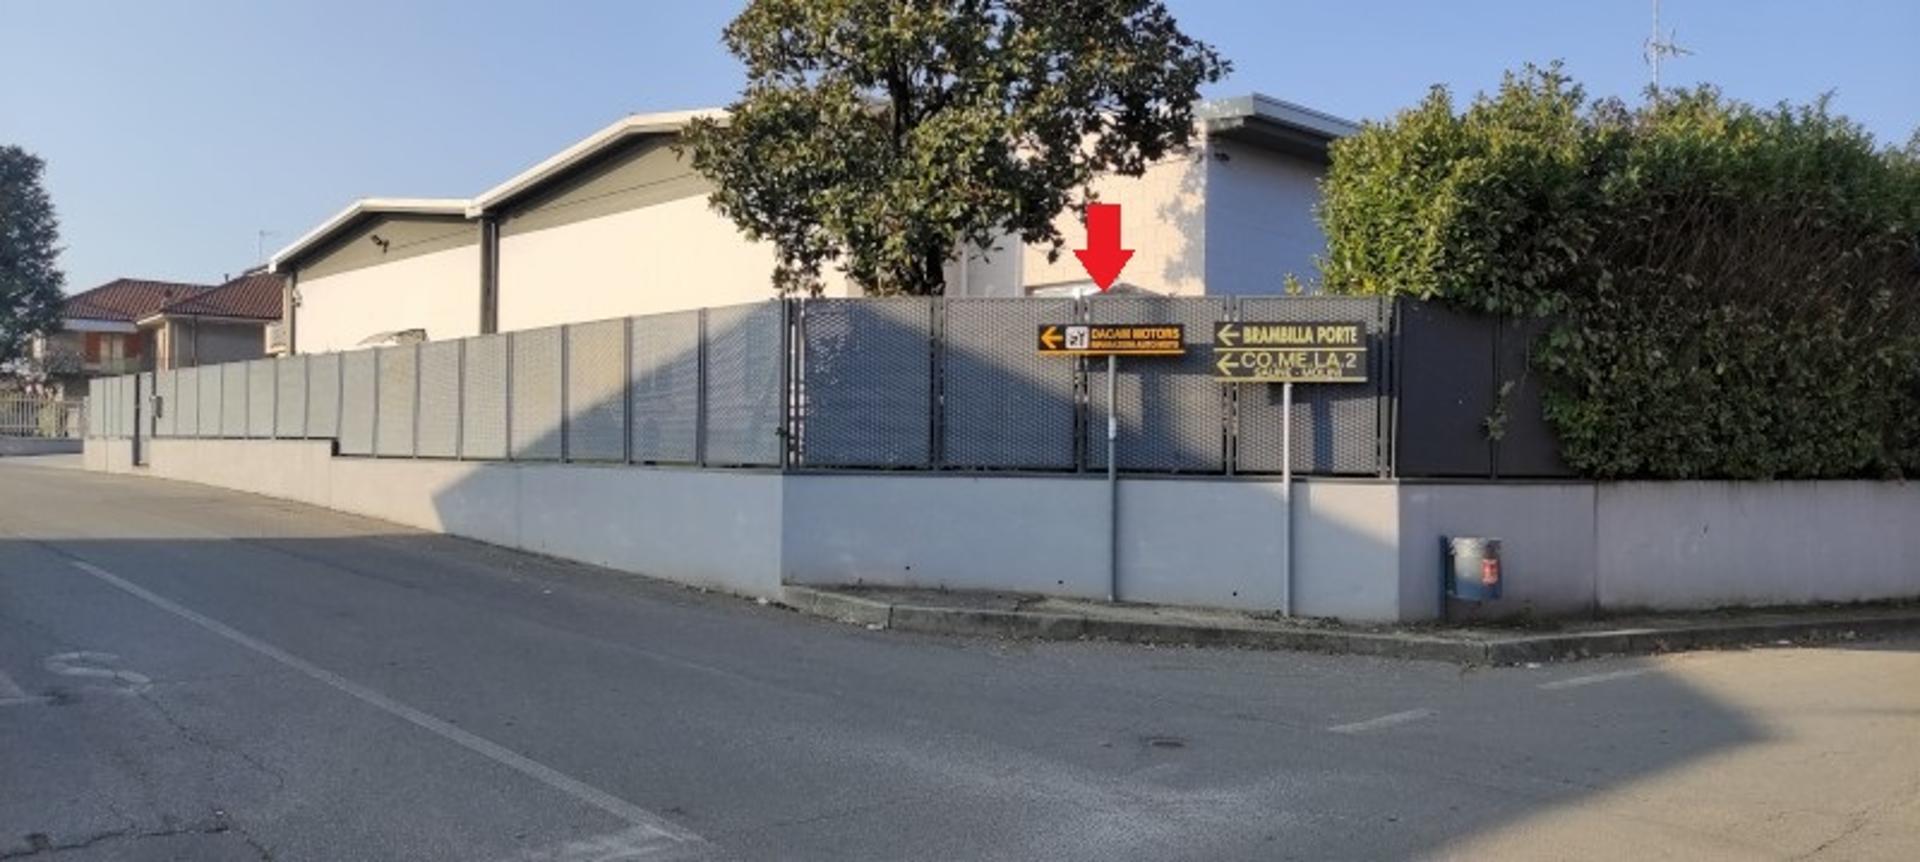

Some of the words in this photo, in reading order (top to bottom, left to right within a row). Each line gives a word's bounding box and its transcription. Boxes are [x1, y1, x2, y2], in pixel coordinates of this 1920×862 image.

[1132, 328, 1181, 340] MOTORS
[1243, 326, 1314, 344] BRAMBILLA
[1317, 326, 1358, 344] PORTE
